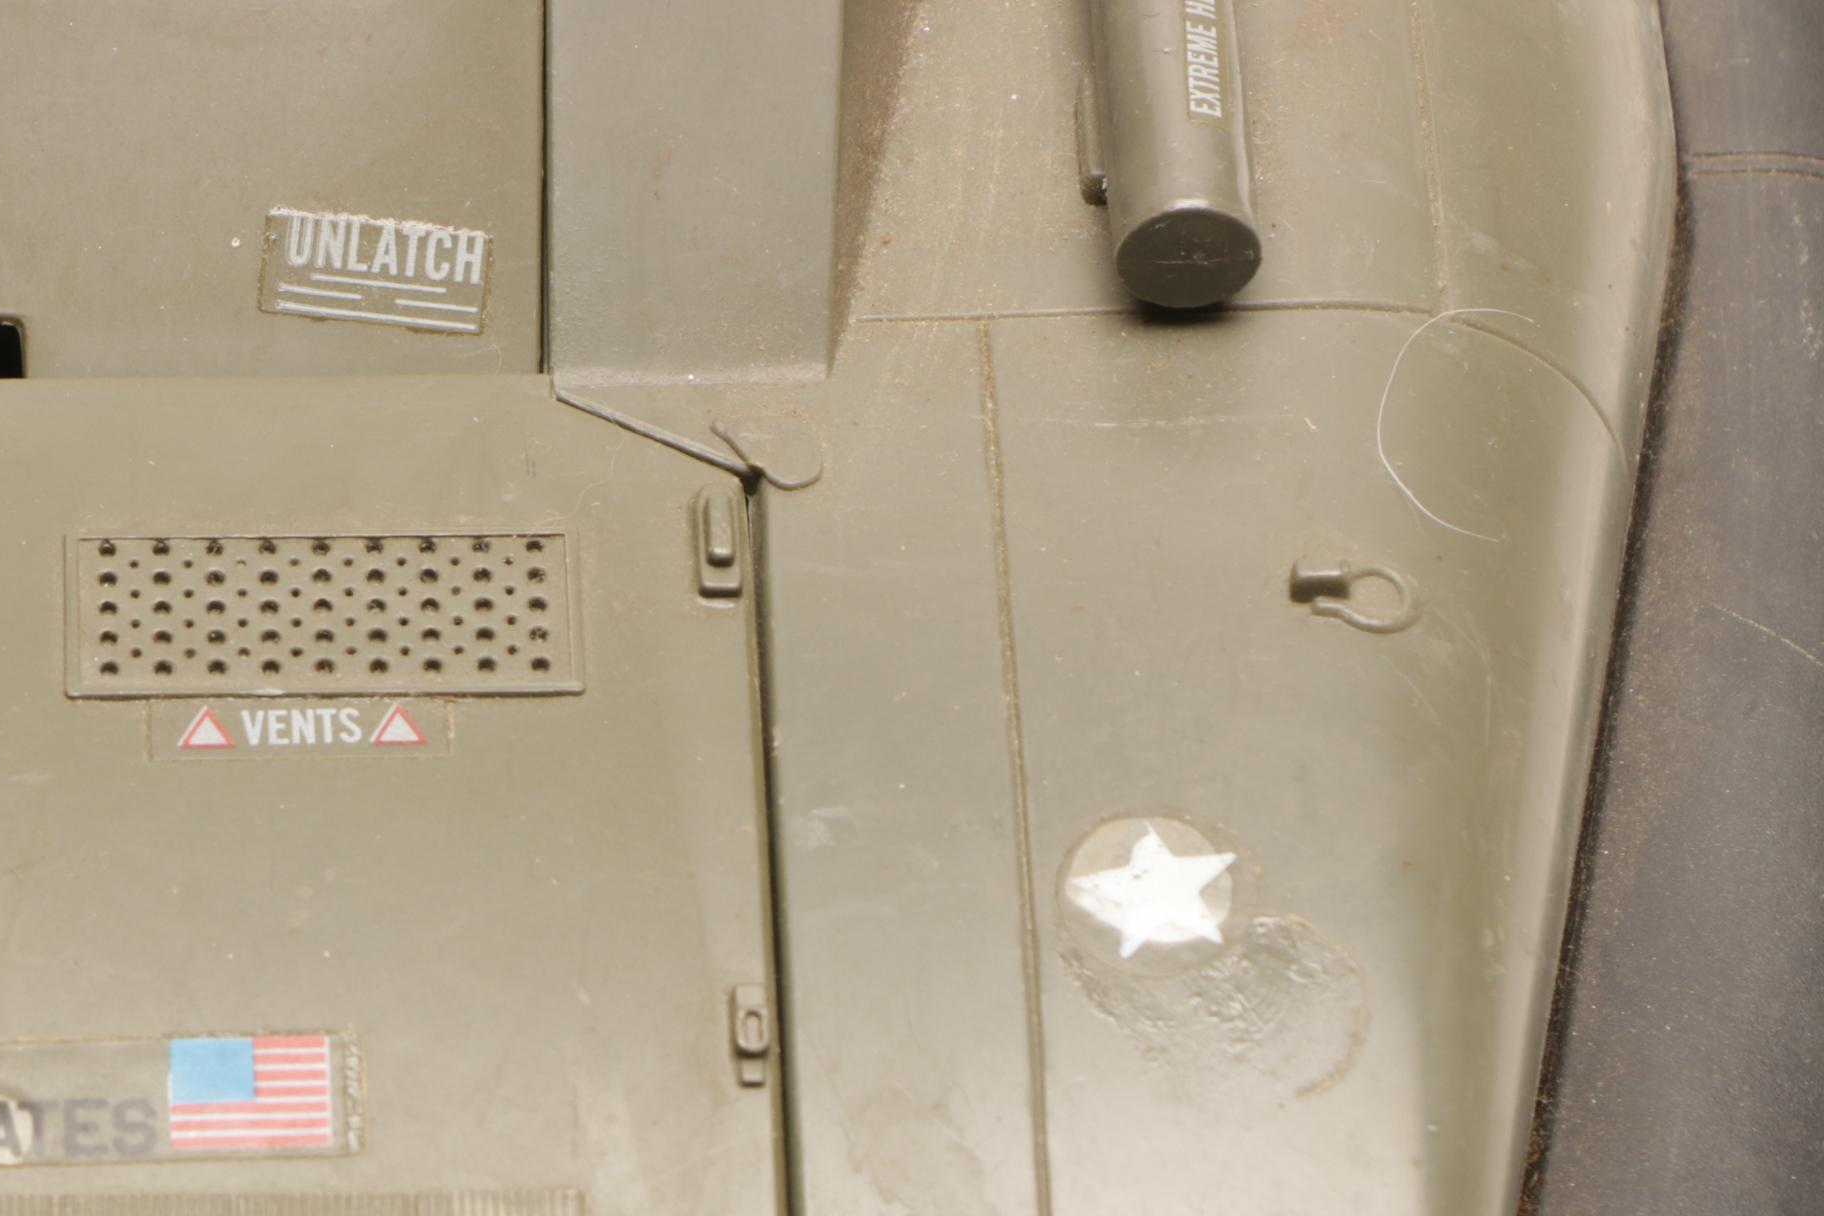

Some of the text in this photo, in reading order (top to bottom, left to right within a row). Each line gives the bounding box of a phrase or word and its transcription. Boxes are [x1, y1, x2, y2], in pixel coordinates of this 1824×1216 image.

[1184, 0, 1222, 118] EXTREME H
[287, 214, 485, 285] UNLATCH
[241, 707, 363, 747] VENTS
